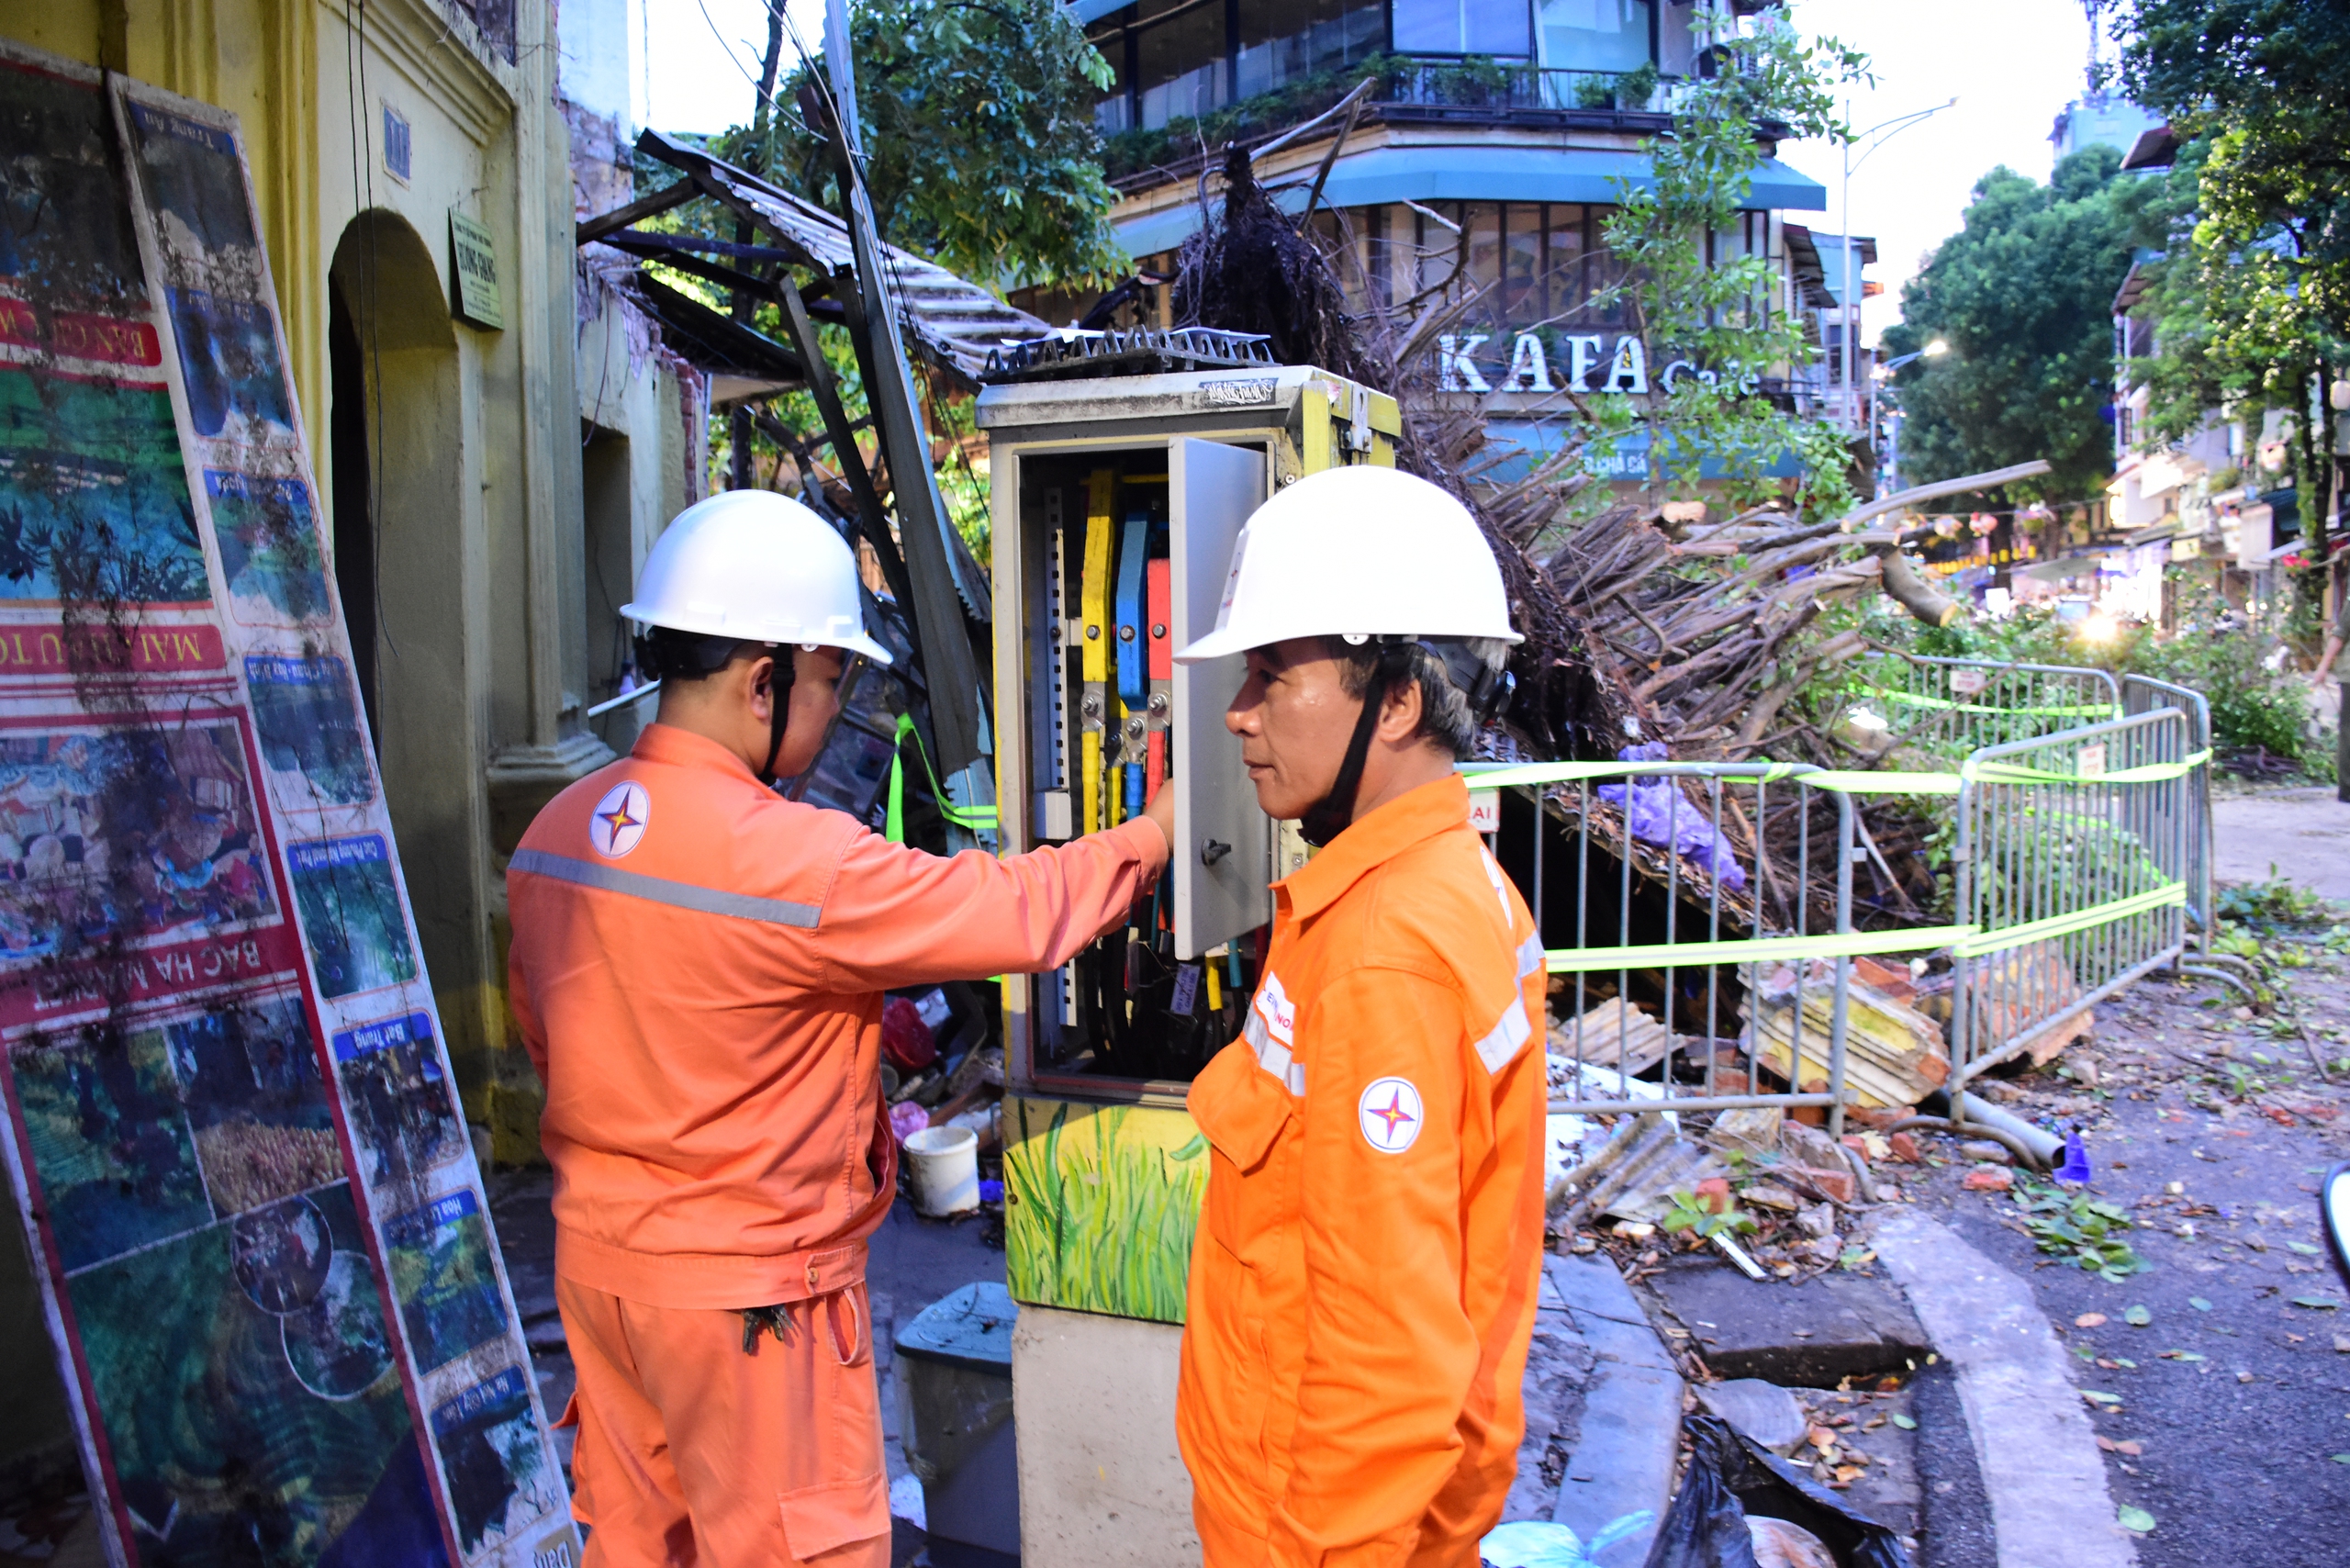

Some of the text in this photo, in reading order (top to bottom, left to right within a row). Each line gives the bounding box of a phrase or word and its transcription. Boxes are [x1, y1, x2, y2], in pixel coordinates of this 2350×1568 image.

[1437, 333, 1649, 394] KAFA
[140, 632, 203, 663] MAI
[152, 951, 195, 983] HA
[200, 940, 261, 976] BAC
